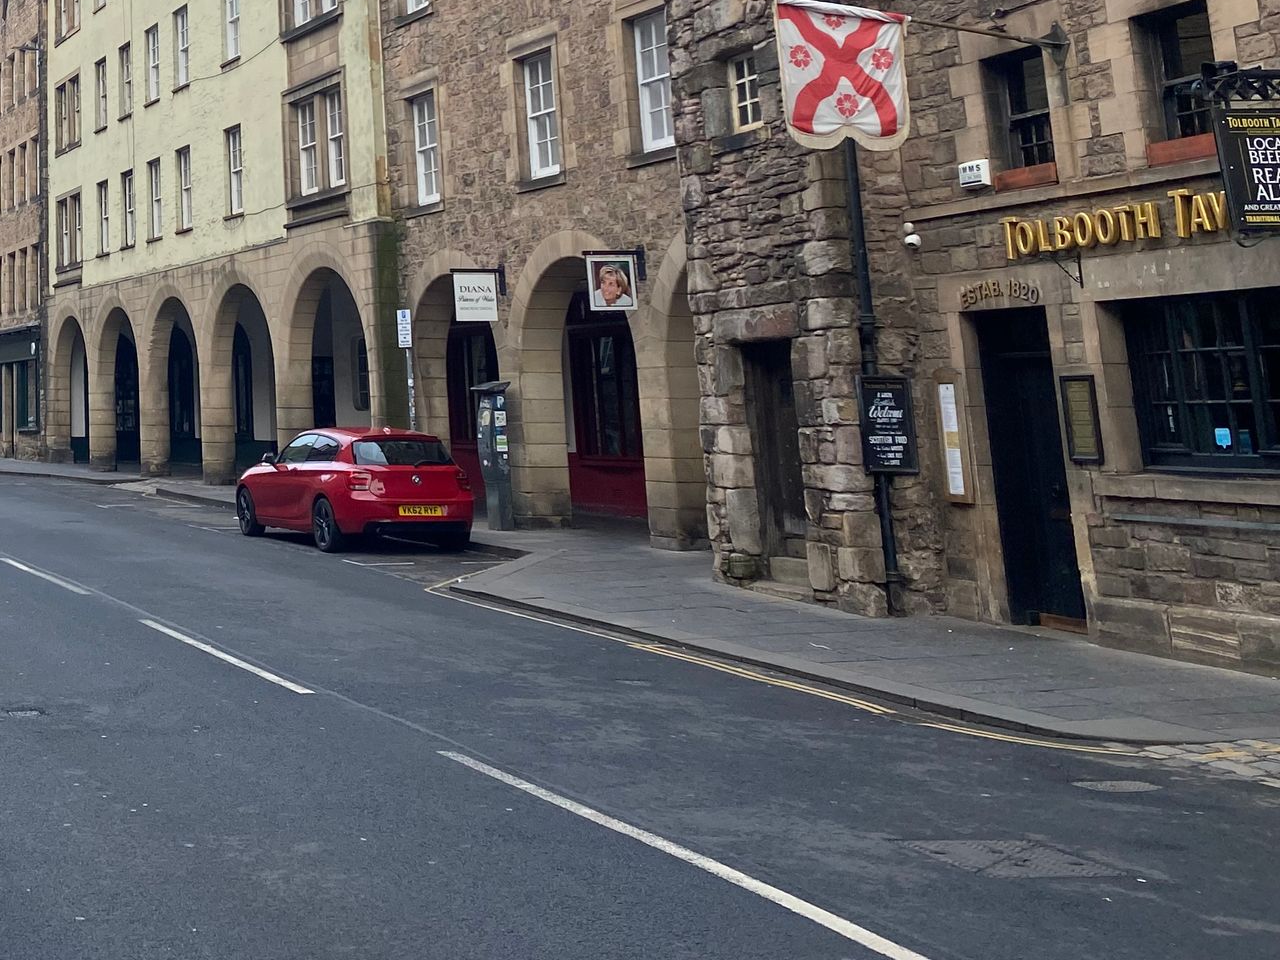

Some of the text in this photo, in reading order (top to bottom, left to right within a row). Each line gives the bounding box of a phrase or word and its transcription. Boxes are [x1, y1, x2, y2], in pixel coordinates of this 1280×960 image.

[1226, 116, 1270, 129] TOLBOOTH
[999, 202, 1161, 260] TOLBOOTH
[459, 285, 492, 294] DIANA
[1008, 279, 1039, 304] 1820
[402, 505, 422, 515] VK62
